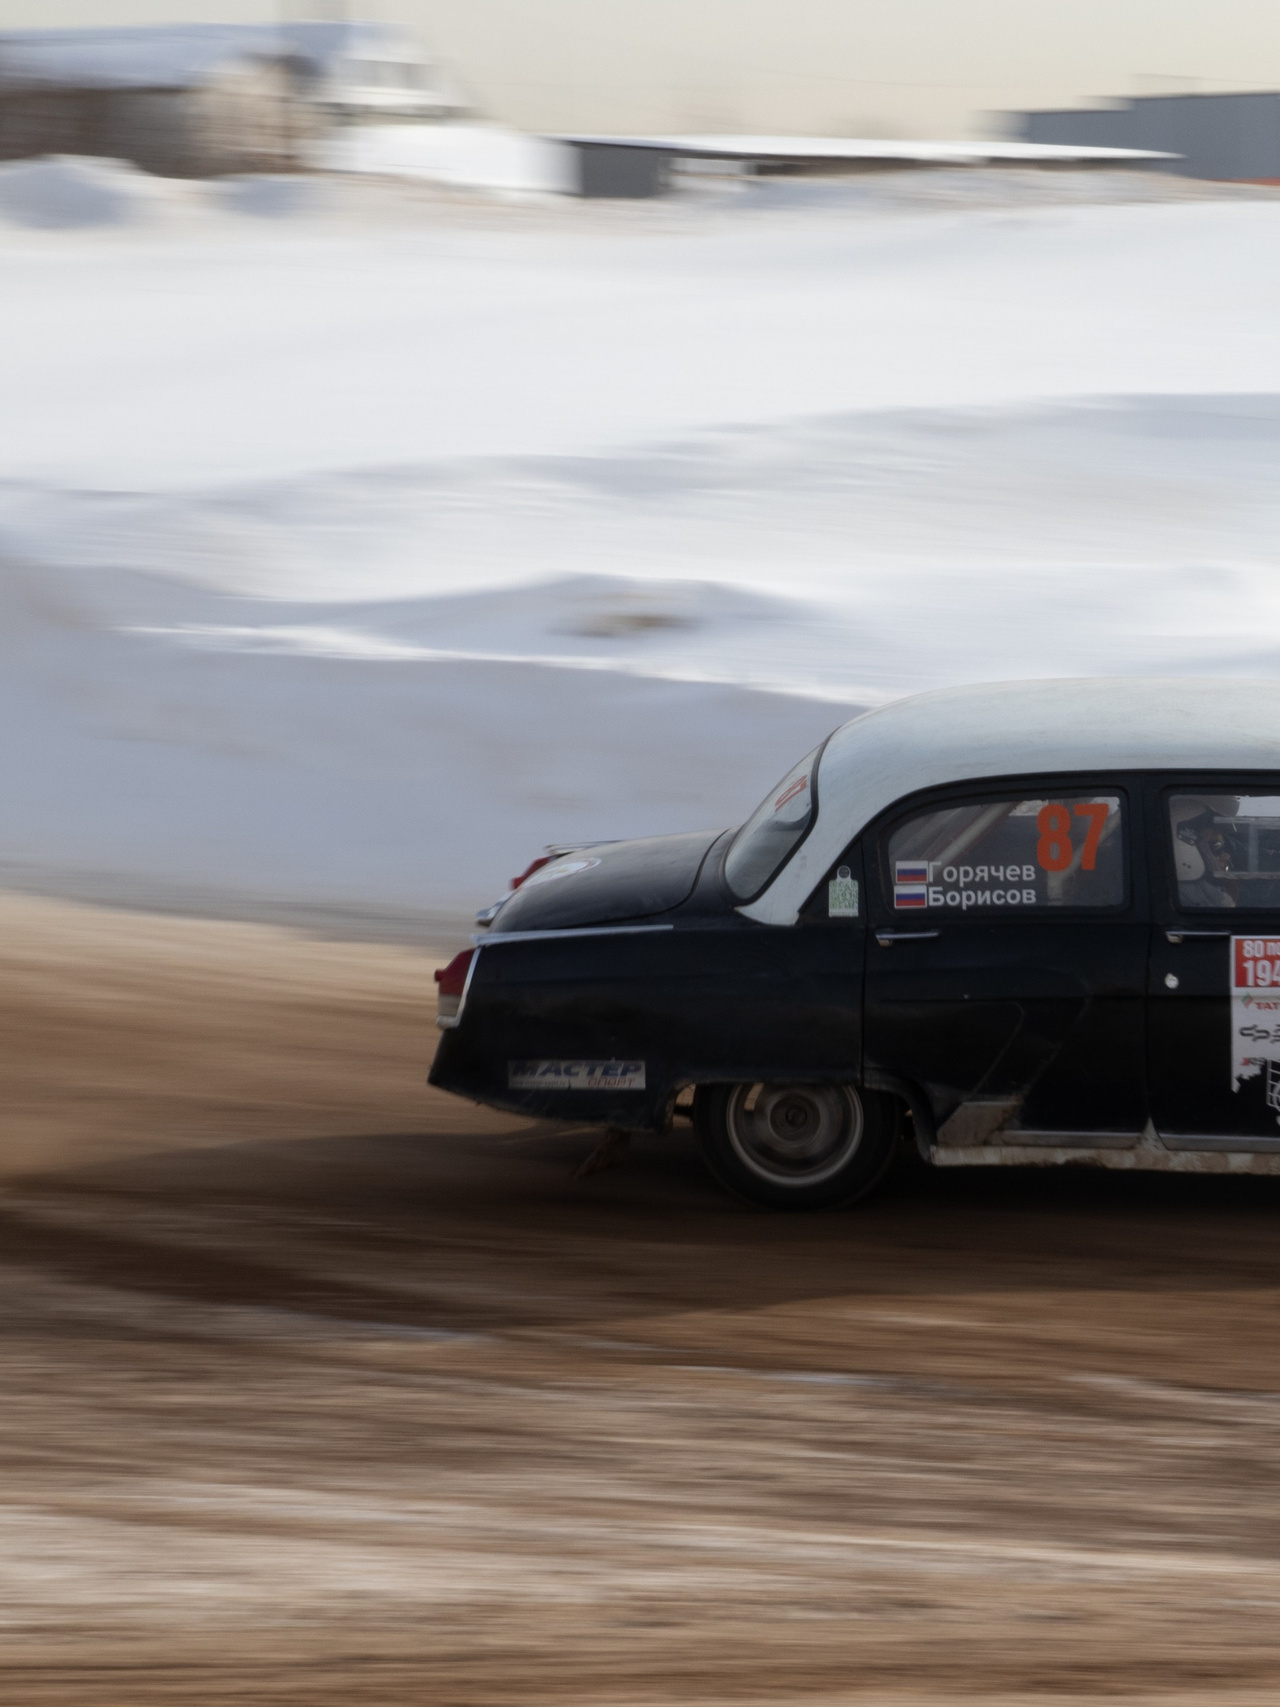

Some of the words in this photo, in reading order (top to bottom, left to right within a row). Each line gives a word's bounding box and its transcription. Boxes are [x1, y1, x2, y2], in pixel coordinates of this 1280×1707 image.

[1036, 803, 1109, 872] 87
[928, 862, 1036, 886] Горячев
[928, 887, 1037, 909] Борисов
[1243, 940, 1264, 958] 80
